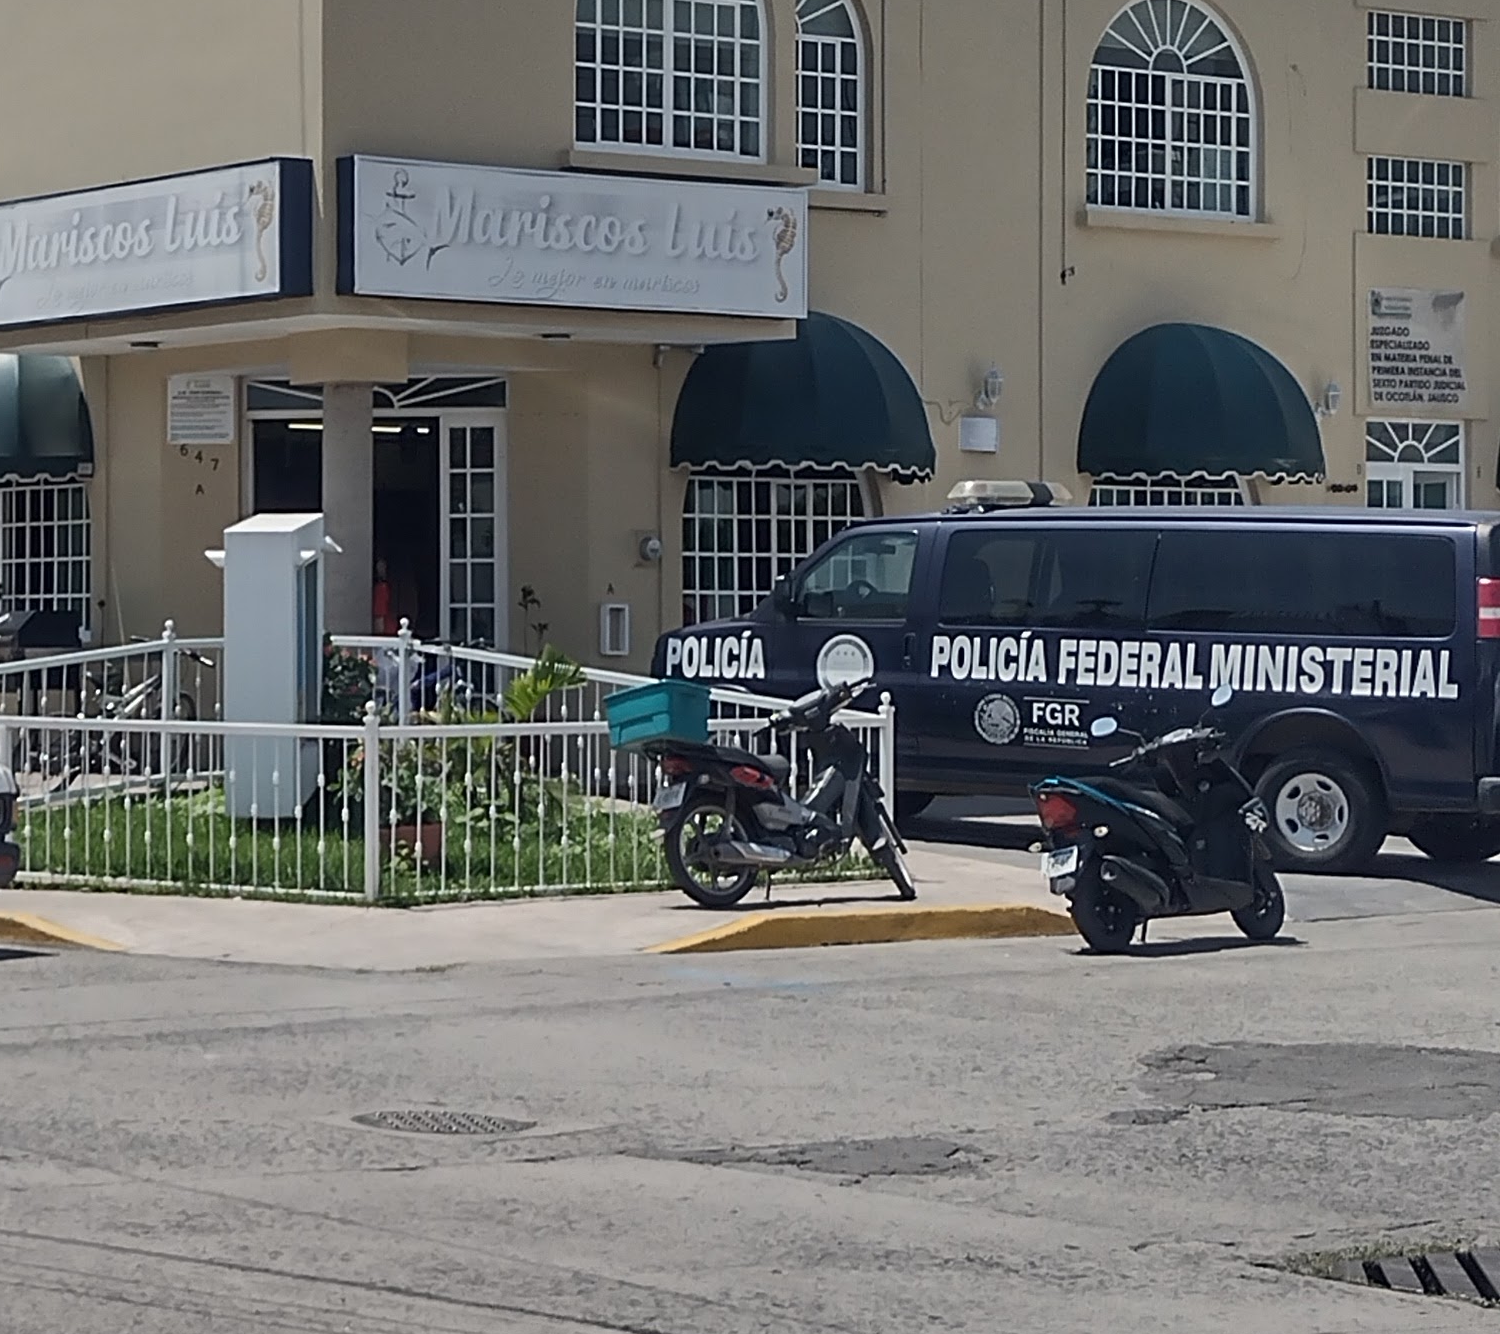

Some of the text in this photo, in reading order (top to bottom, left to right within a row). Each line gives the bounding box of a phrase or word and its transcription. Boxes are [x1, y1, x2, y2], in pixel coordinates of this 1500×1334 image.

[433, 186, 760, 263] Mariscos Luis
[0, 211, 154, 275] Mariscos
[1371, 326, 1410, 337] JUZGADO
[1370, 339, 1430, 351] ESPECIALIZADO
[1371, 352, 1453, 365] EN MATERIA PENAL DE
[1372, 366, 1463, 378] PRIMERA INSTANCIA DEL
[1372, 378, 1397, 388] SEXTO
[1399, 379, 1431, 390] PARTIDO
[1374, 391, 1383, 401] DE
[1427, 392, 1460, 404] JALISCO
[195, 484, 205, 495] A
[666, 630, 765, 679] POLICÍA
[930, 631, 1459, 698] POLICÍA FEDERAL MINISTERIAL
[1032, 702, 1080, 727] FGR
